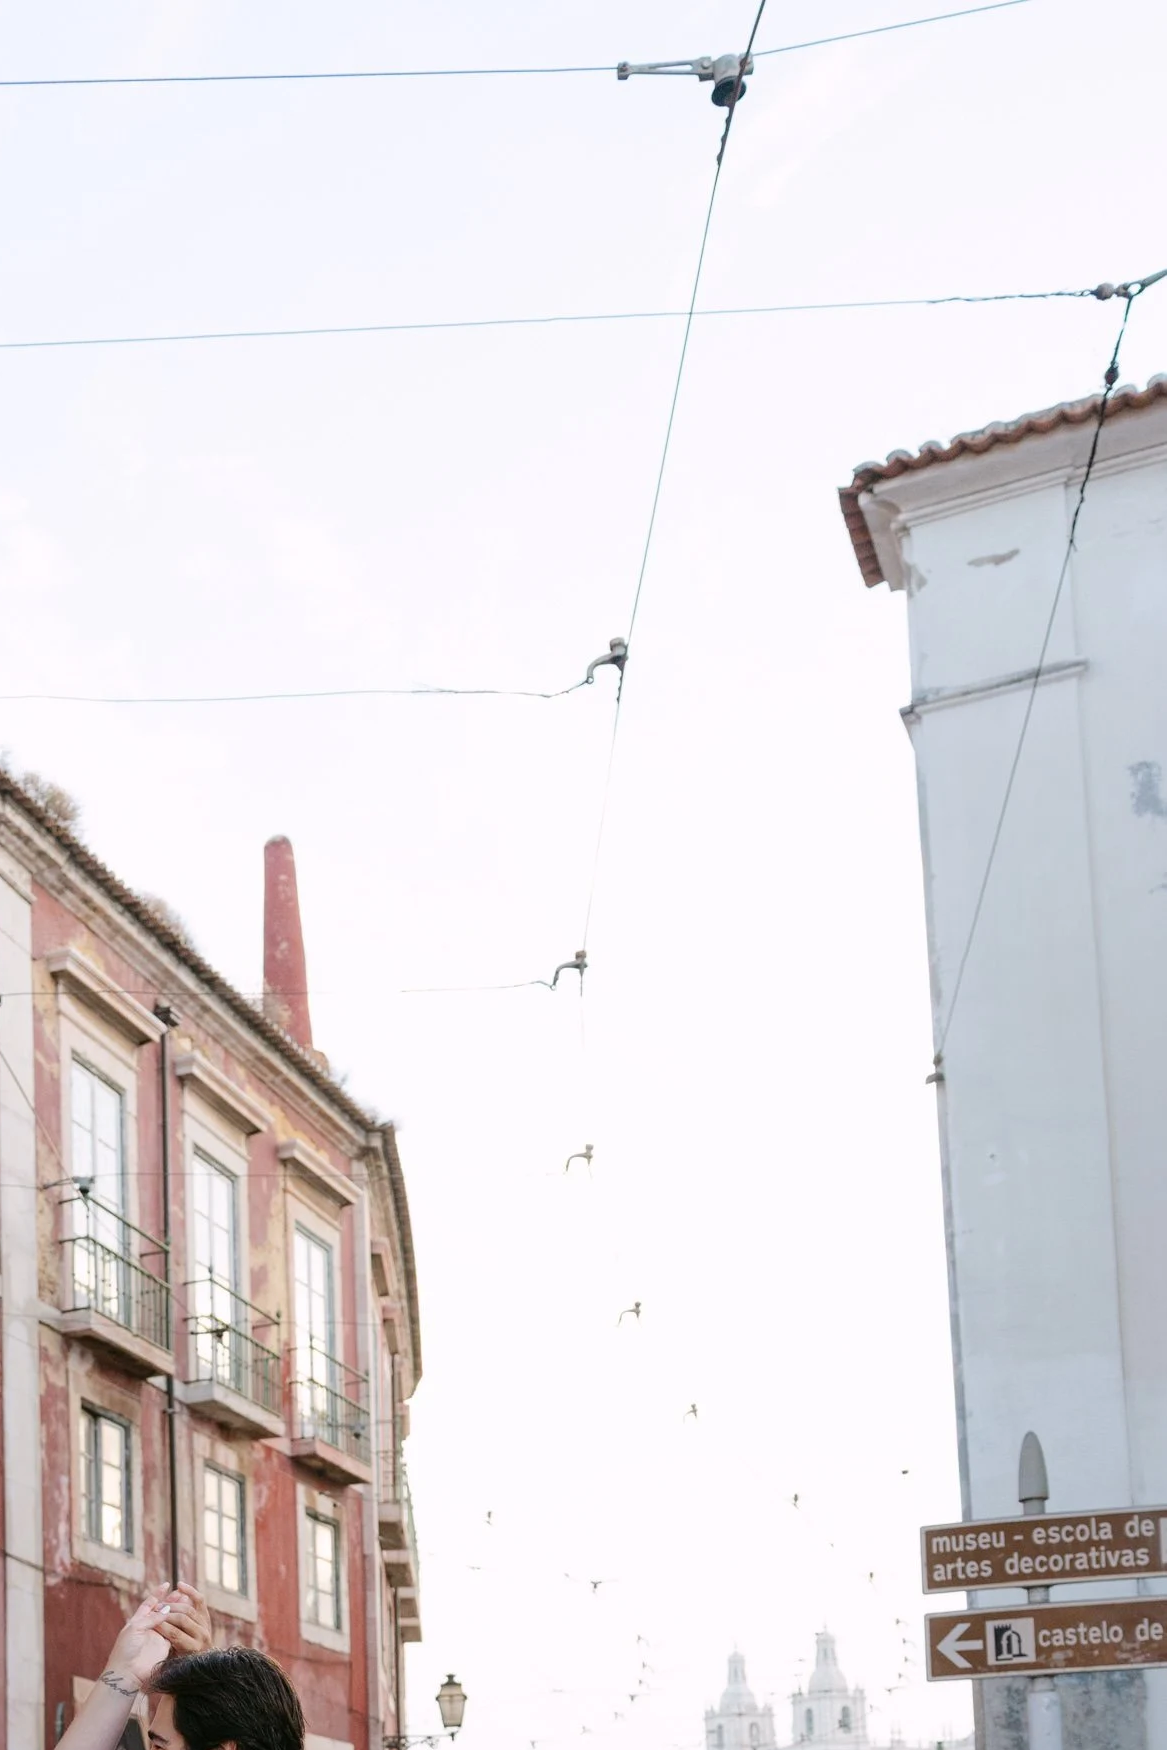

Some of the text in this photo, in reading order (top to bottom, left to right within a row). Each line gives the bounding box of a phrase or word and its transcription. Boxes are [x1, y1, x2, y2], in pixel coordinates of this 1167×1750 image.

[932, 1531, 1005, 1554] museu
[1032, 1517, 1113, 1545] escola
[1125, 1515, 1155, 1538] de
[933, 1547, 1150, 1582] artes decorativas
[1039, 1617, 1164, 1648] castelo de
